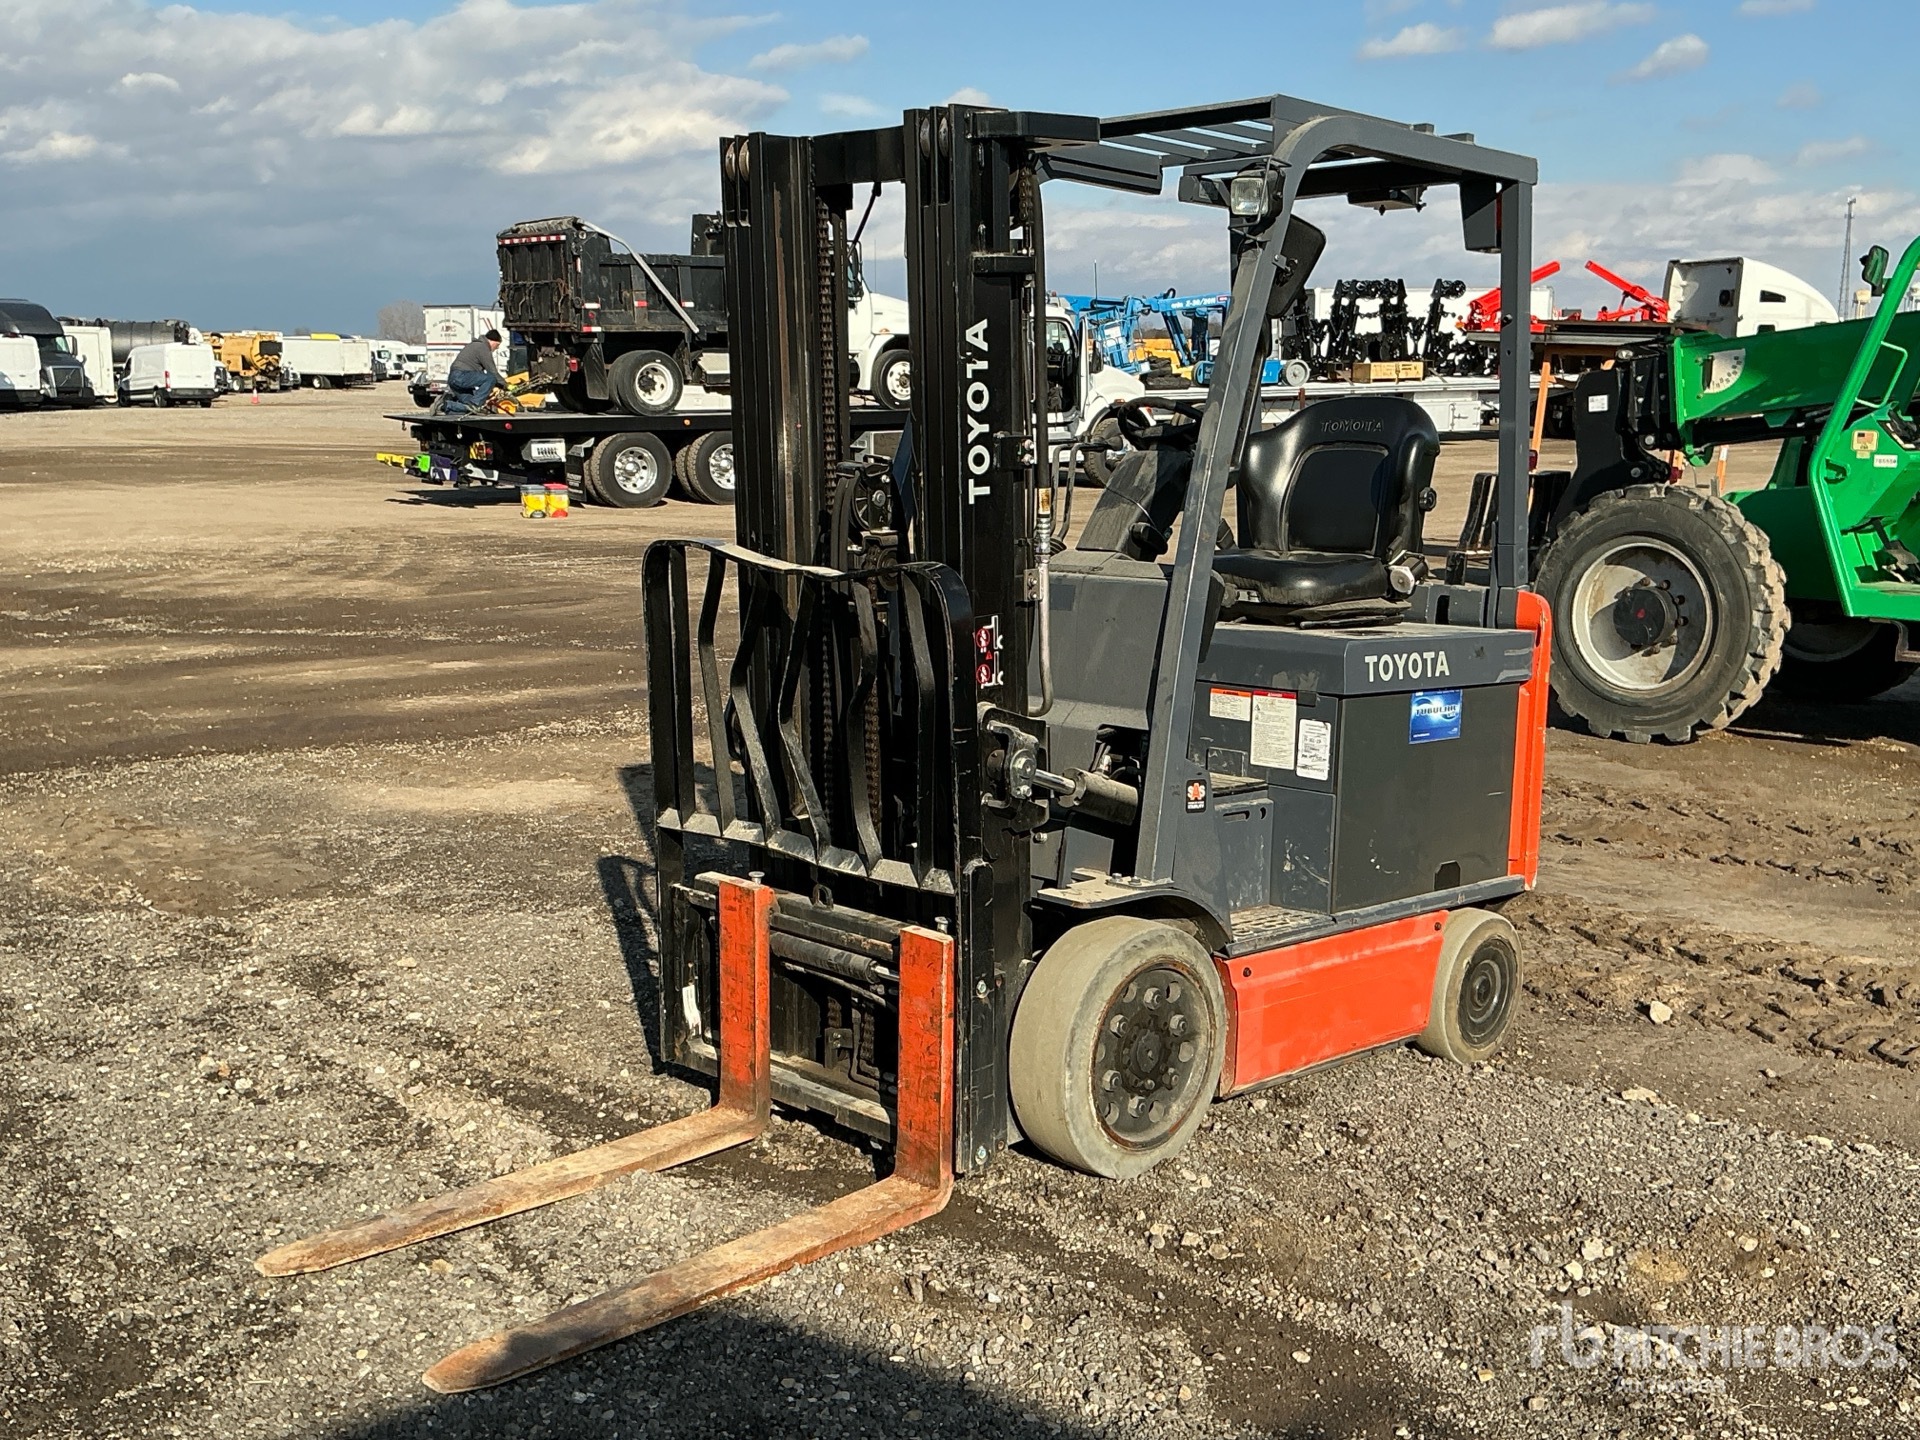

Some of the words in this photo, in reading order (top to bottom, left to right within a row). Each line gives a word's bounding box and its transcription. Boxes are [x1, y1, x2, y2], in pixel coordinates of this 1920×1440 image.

[966, 318, 991, 504] TOYOTA
[1321, 420, 1384, 433] TOYOTA
[1364, 650, 1450, 682] TOYOTA
[1187, 782, 1206, 801] SAS
